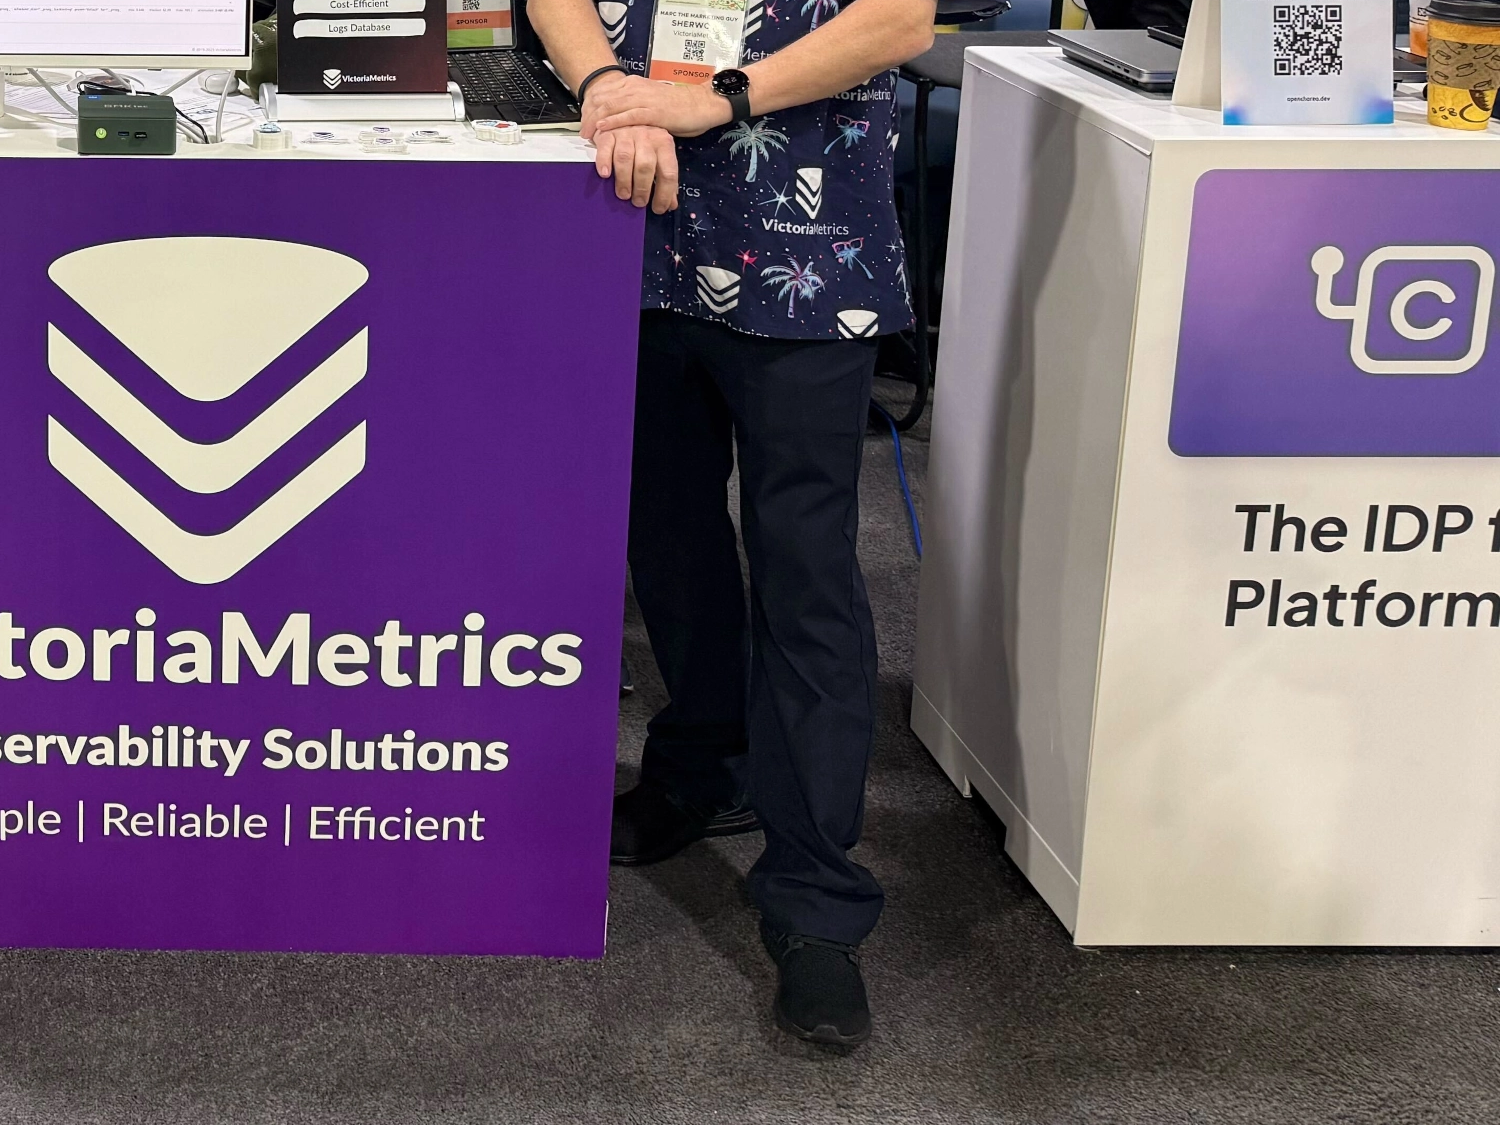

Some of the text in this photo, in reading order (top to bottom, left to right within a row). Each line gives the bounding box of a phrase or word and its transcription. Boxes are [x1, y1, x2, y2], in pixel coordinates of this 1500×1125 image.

[329, 0, 389, 9] Cost-Efficient
[456, 18, 489, 26] SPONSOR
[328, 22, 392, 34] Logs Database
[342, 73, 397, 83] VictoriaMetrics
[673, 69, 710, 79] SPONSOR
[1286, 95, 1332, 104] openchoreo.dev
[1234, 503, 1348, 553] The
[1363, 504, 1474, 553] IDP
[262, 728, 509, 774] Solutions
[102, 802, 268, 840] Reliable
[309, 804, 486, 842] Efficient
